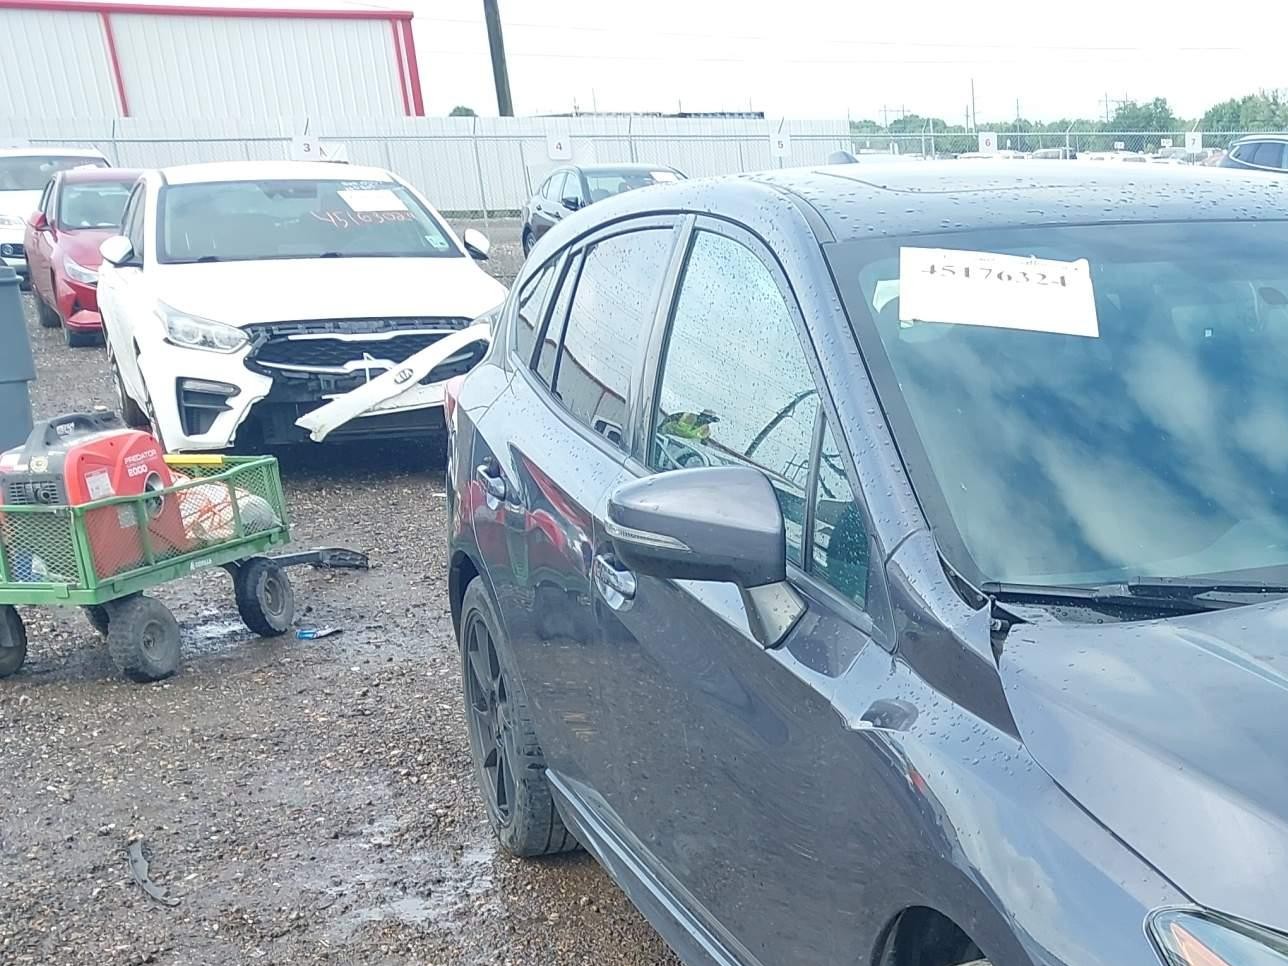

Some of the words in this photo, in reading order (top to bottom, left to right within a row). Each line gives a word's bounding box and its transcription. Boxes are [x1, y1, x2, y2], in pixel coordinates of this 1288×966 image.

[303, 143, 311, 152] 3
[555, 142, 562, 151] 4
[921, 264, 1067, 288] 45176324
[124, 449, 157, 464] PREDATOR
[128, 464, 147, 478] 2000
